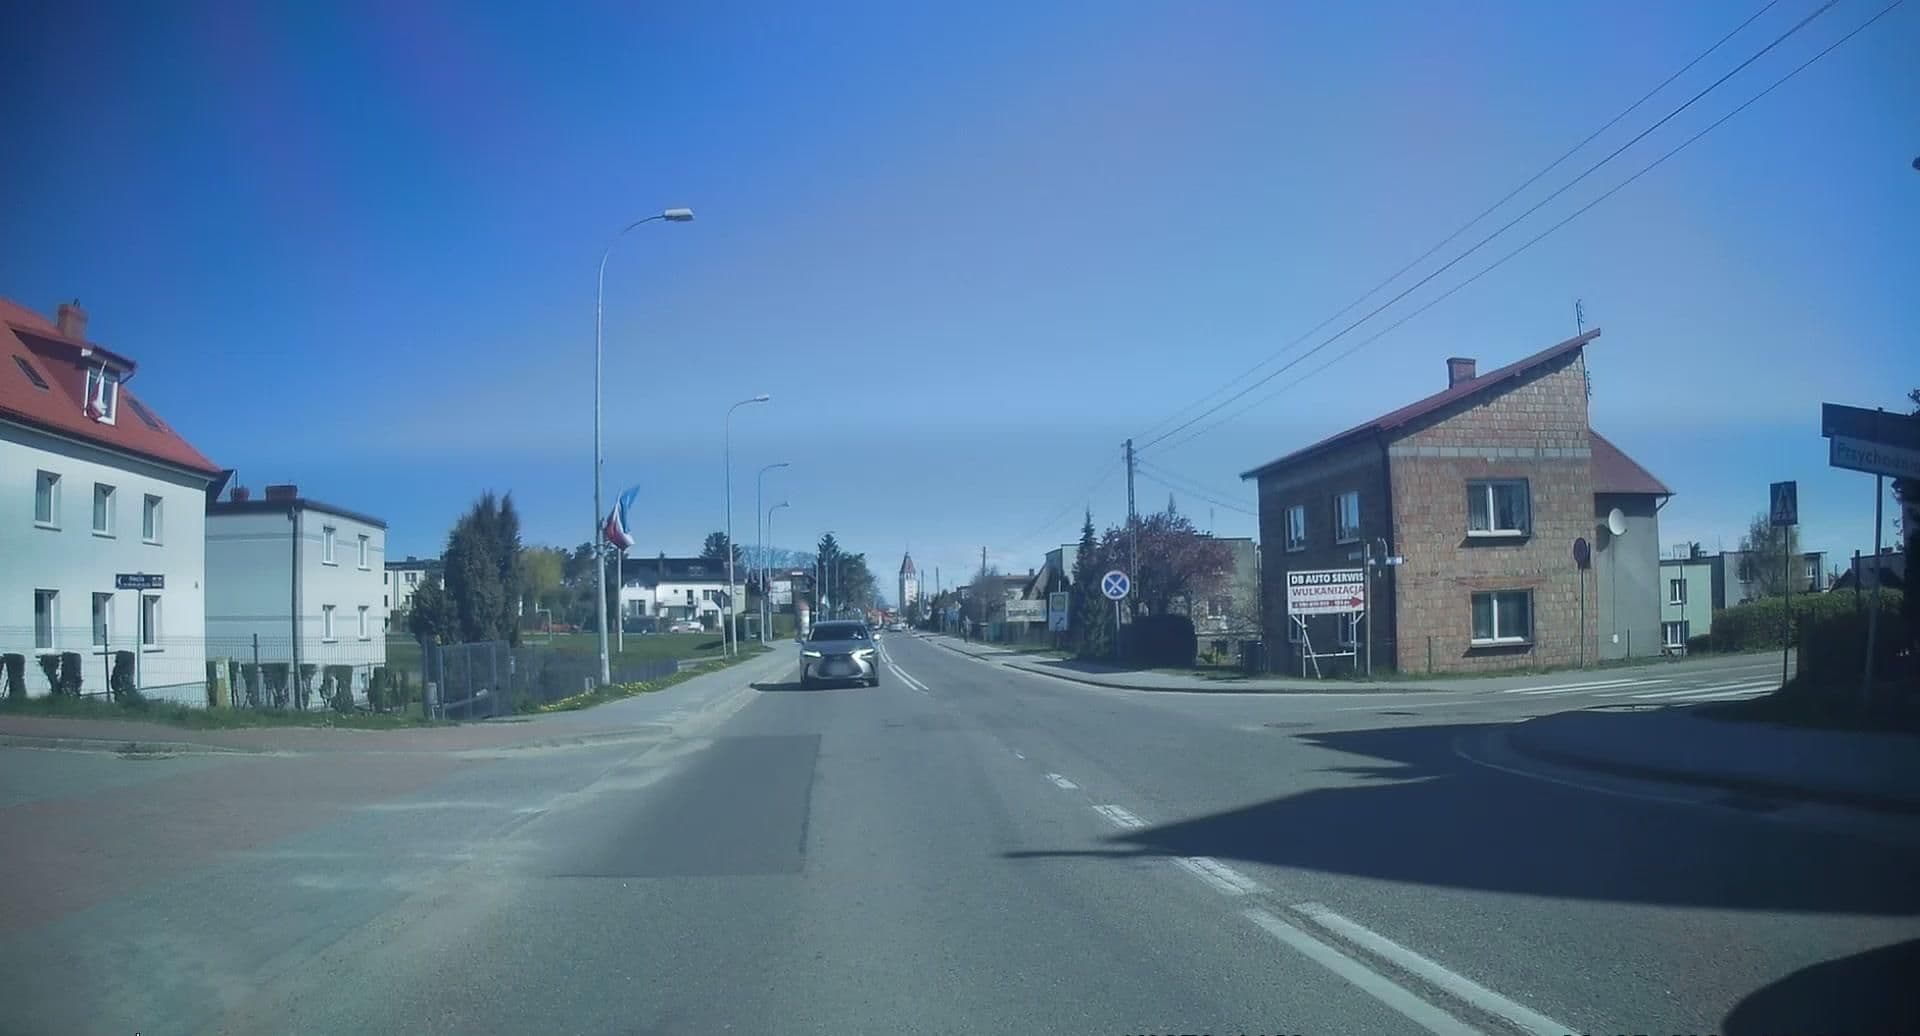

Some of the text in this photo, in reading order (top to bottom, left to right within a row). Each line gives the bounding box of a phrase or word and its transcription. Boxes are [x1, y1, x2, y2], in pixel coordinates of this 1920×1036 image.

[1291, 572, 1363, 585] DB AUTO SERWIS
